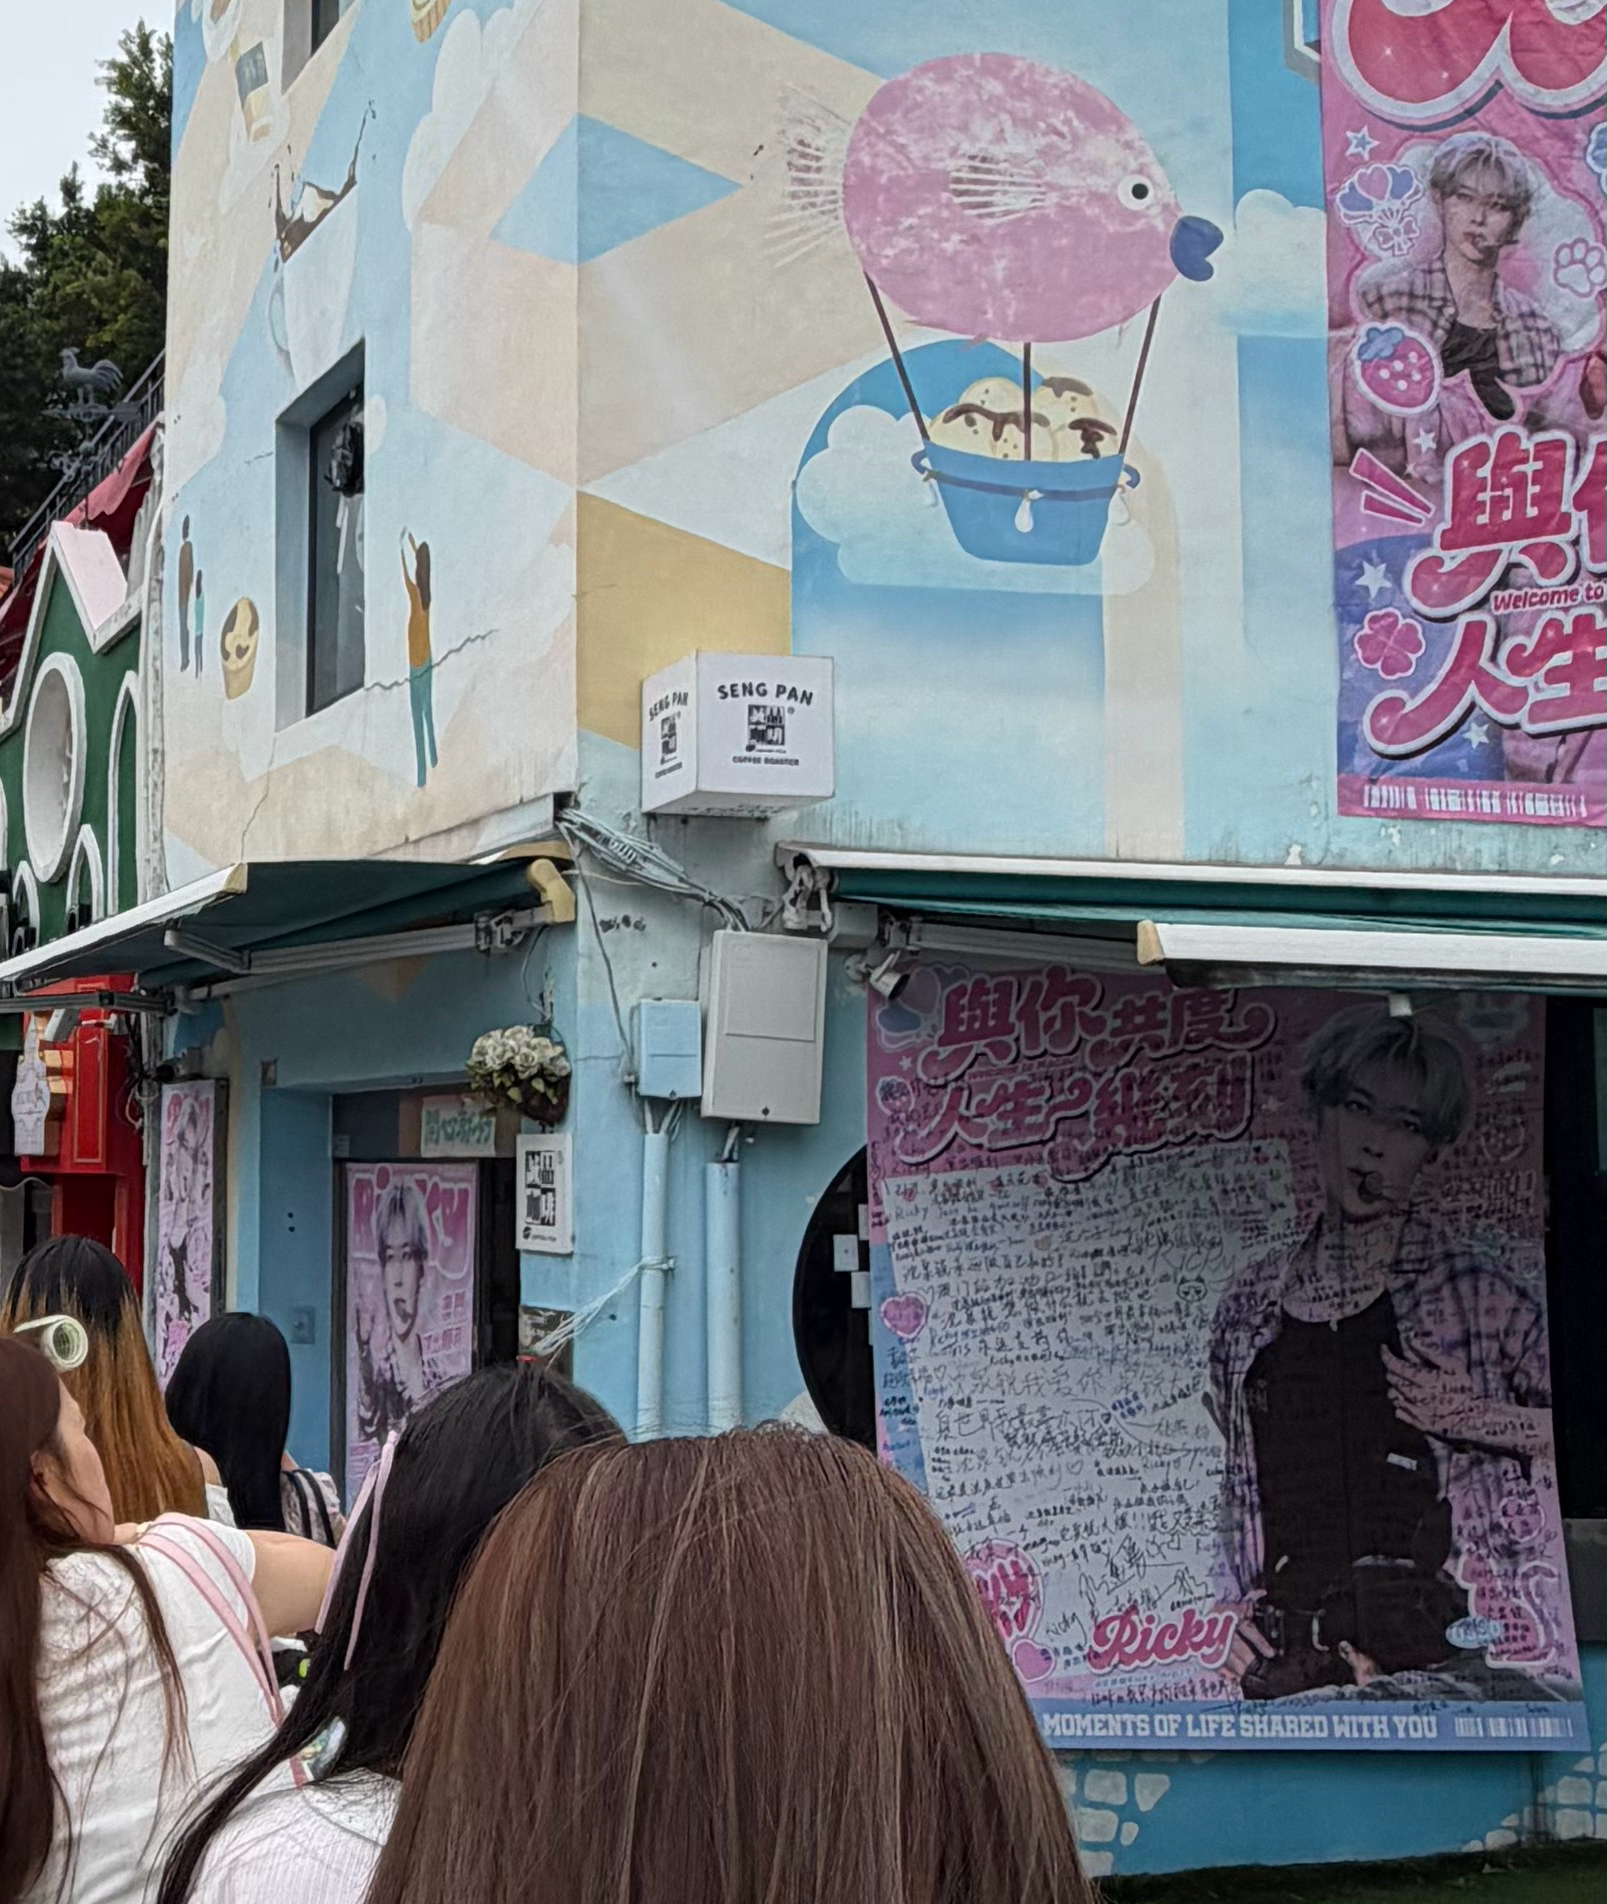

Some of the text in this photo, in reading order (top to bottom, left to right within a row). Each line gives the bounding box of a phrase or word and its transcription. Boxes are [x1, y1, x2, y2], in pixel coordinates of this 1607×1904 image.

[1492, 584, 1605, 612] Welcome to
[671, 691, 689, 707] PAN
[717, 681, 814, 706] SENG PAN
[1086, 1604, 1240, 1676] Ricky
[1044, 1713, 1437, 1738] MOMENTS OF LIFE SHARED WITH YOU
